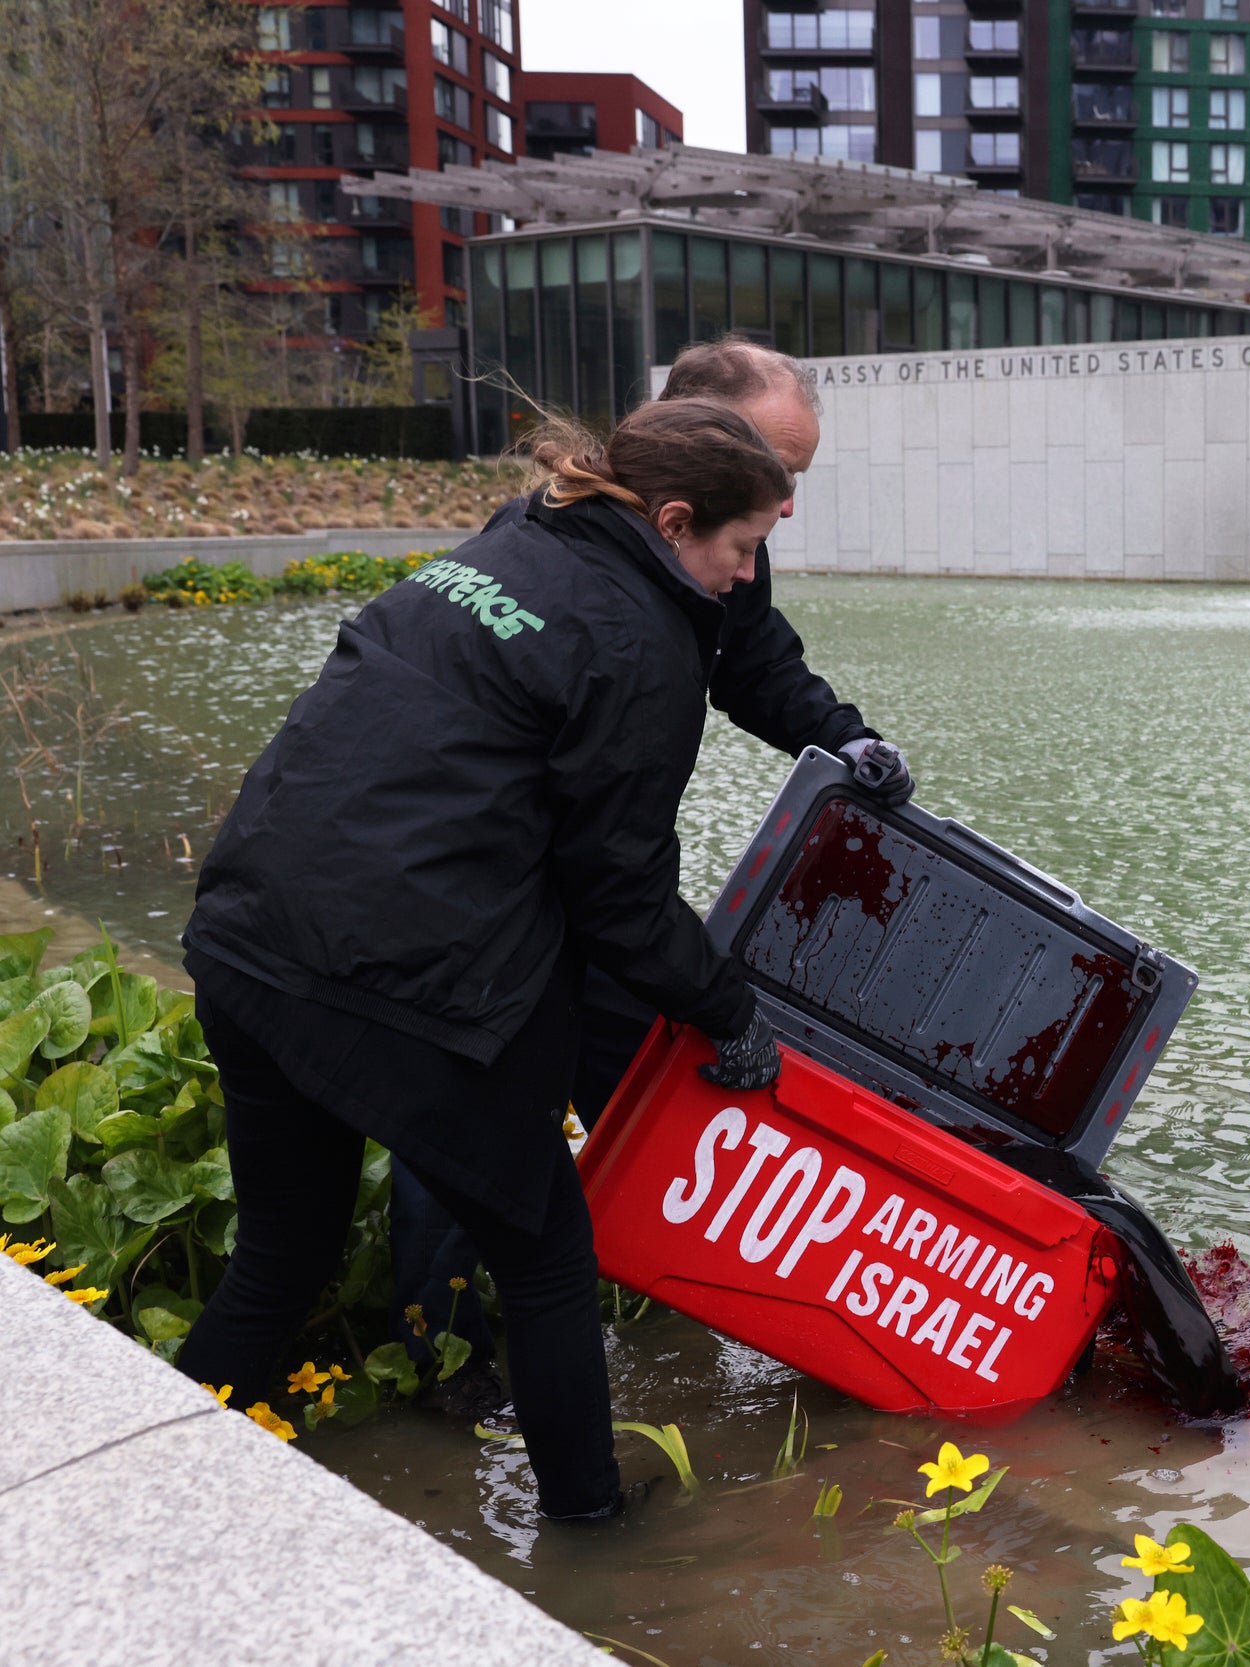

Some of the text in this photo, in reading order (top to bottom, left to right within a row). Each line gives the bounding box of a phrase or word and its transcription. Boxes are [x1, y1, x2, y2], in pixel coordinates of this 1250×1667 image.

[807, 363, 883, 385] BASSY
[898, 362, 925, 381] OF
[941, 358, 985, 379] THE
[1001, 354, 1101, 377] UNITED
[1118, 347, 1225, 372] STATES
[662, 1107, 866, 1279] STOP
[862, 1194, 1055, 1321] ARMING
[825, 1249, 1013, 1383] ISRAEL
